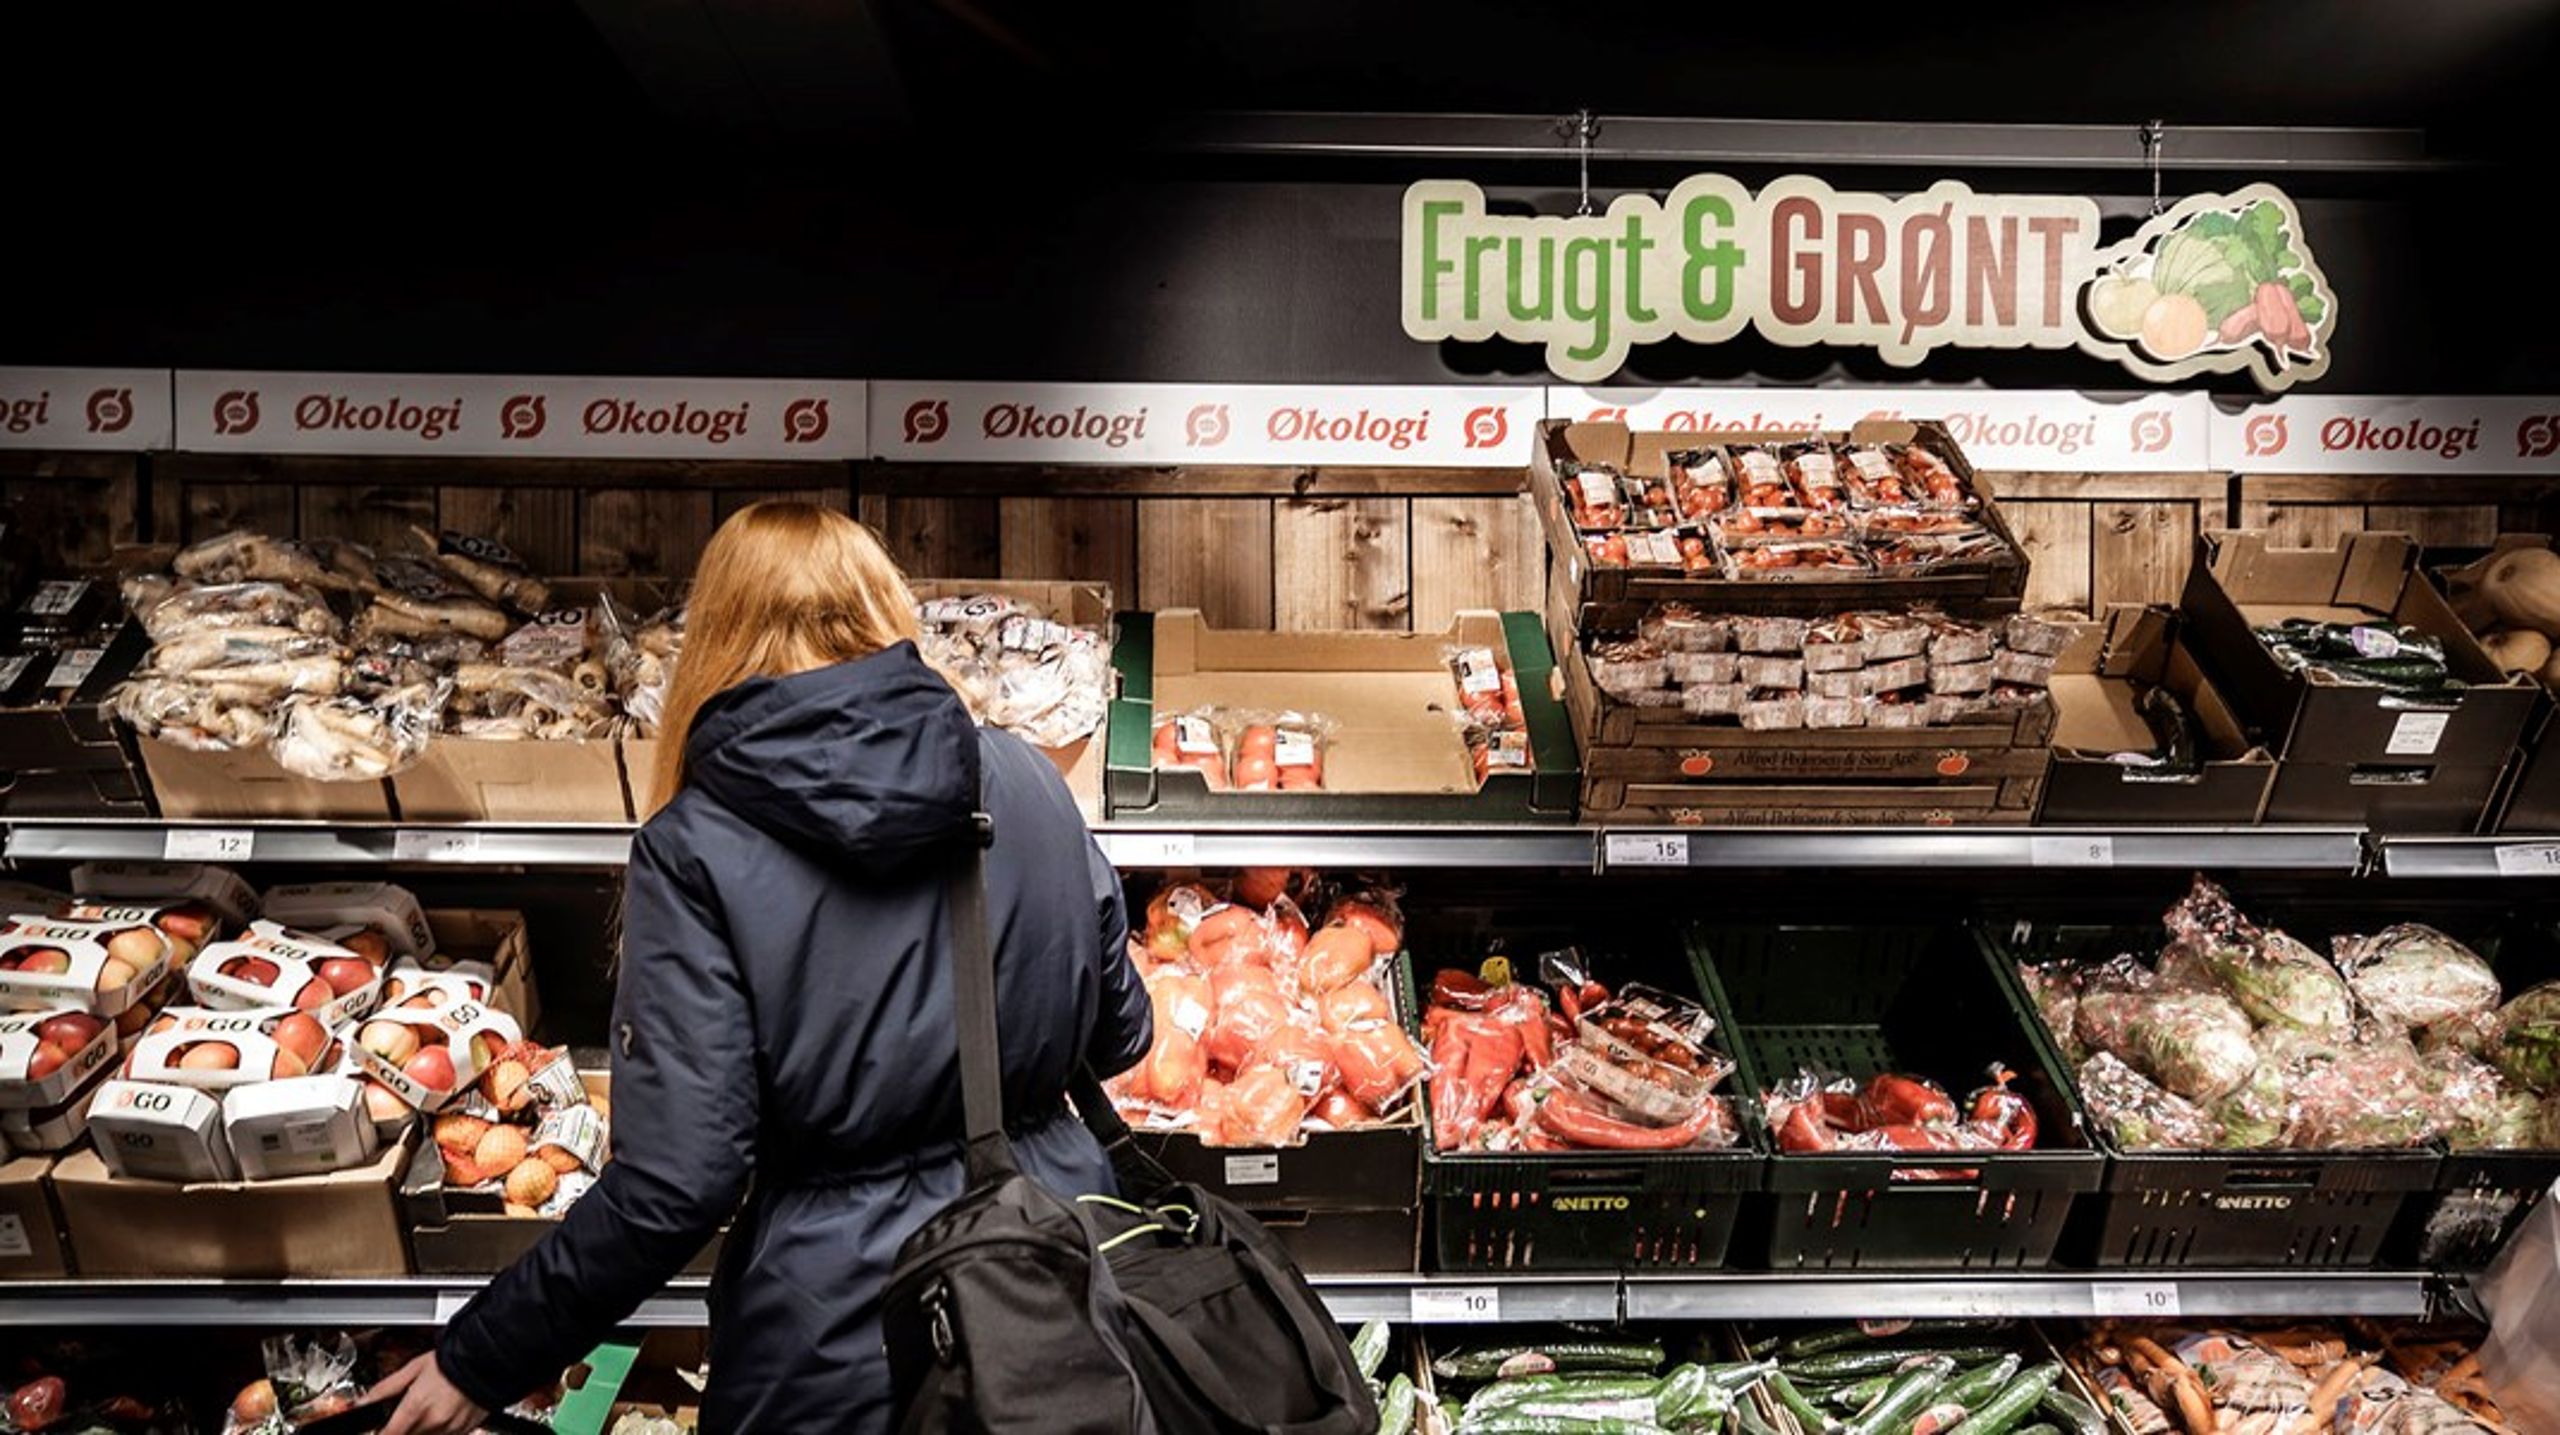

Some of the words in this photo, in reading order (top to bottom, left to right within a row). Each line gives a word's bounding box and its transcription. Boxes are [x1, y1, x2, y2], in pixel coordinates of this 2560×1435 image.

[1420, 200, 1660, 362] Frugt
[1680, 194, 1746, 323] &
[1768, 194, 2080, 345] GRØNT
[294, 394, 464, 441] Økologi
[582, 397, 750, 444] Økologi
[982, 402, 1149, 448] Økologi
[1266, 406, 1431, 450] Økologi
[2319, 415, 2482, 460] Økologi
[1563, 1196, 1630, 1211] NETTO
[2227, 1195, 2291, 1209] NETTO
[1464, 1295, 1487, 1311] 10
[2144, 1290, 2166, 1306] 10
